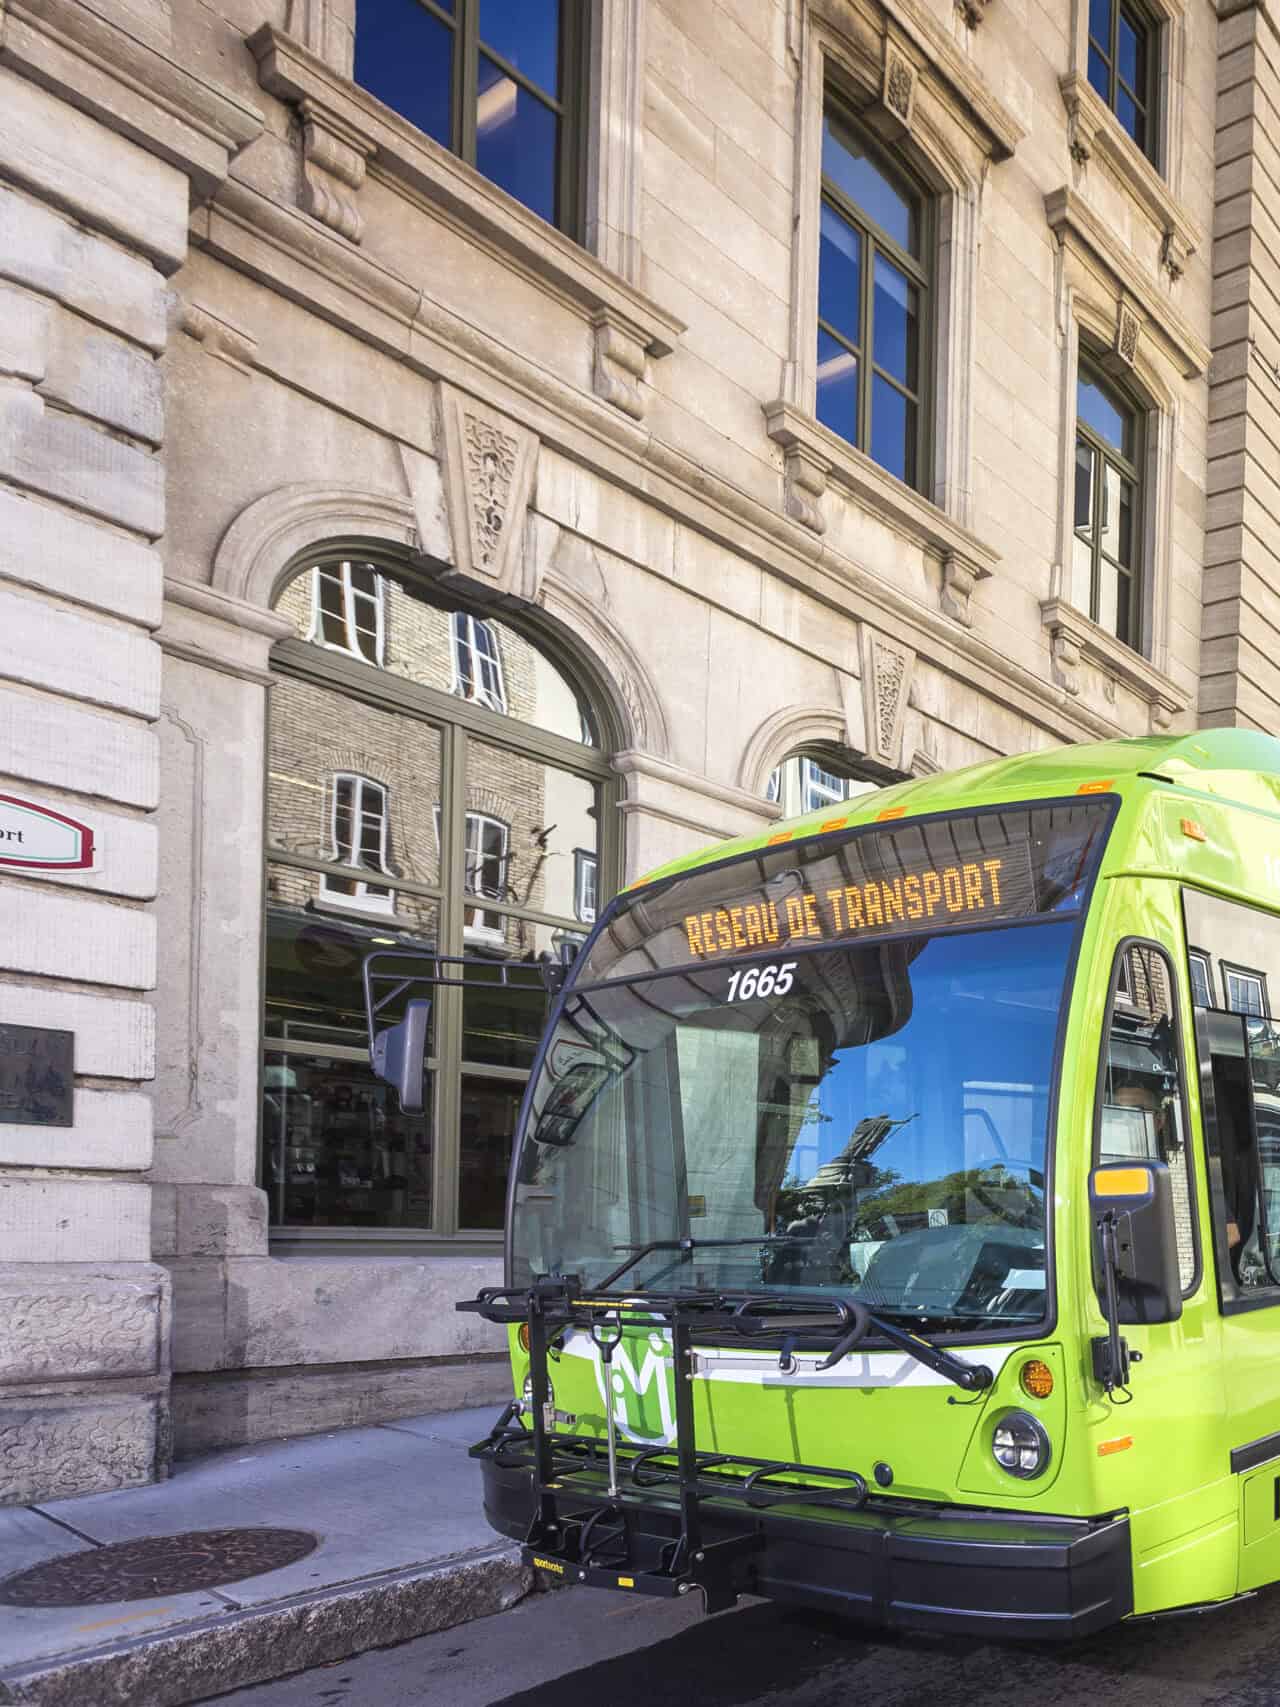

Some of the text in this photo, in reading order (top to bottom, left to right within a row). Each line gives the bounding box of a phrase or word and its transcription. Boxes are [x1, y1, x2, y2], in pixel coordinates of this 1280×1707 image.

[685, 859, 1004, 954] RESEAU DE TRANSPORT
[727, 962, 798, 1001] 1665
